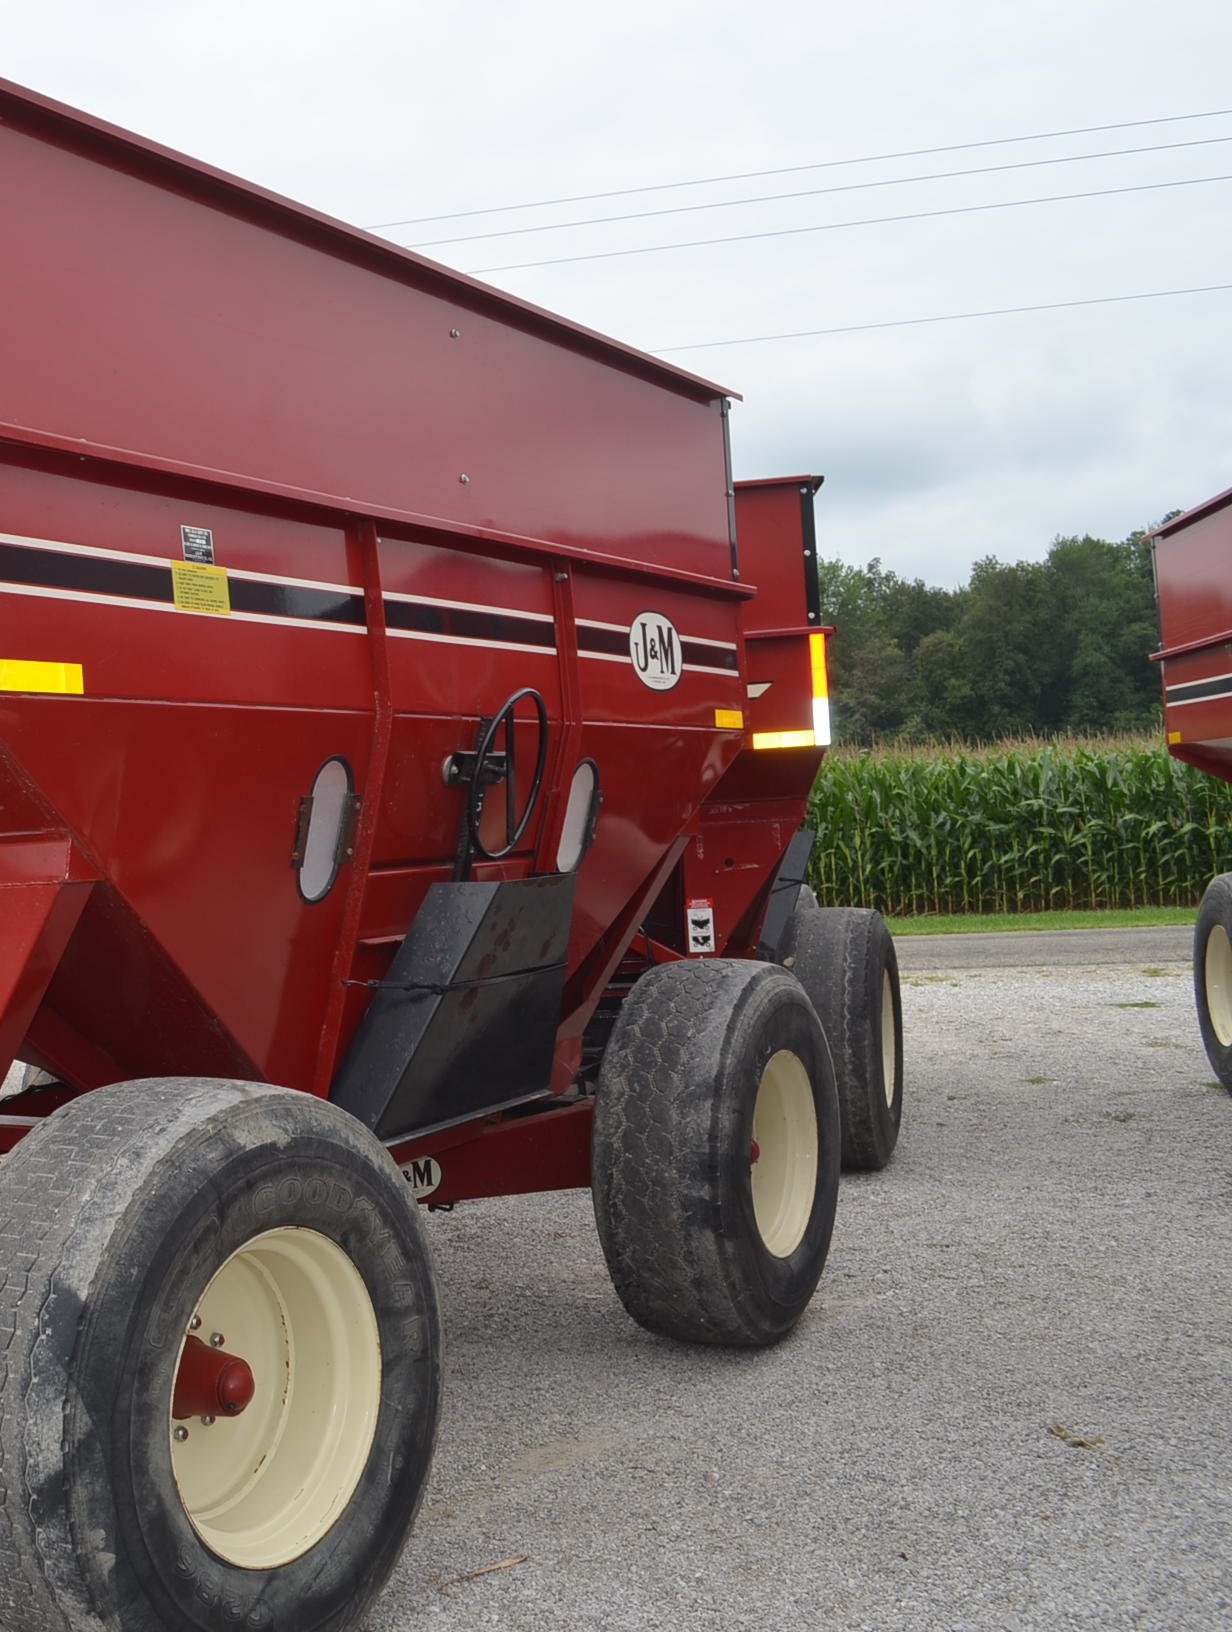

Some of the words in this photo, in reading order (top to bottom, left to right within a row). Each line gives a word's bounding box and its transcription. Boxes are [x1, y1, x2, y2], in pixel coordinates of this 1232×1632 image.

[634, 622, 677, 676] J&M
[402, 1159, 434, 1189] &M
[252, 1175, 423, 1354] GOODYEAR
